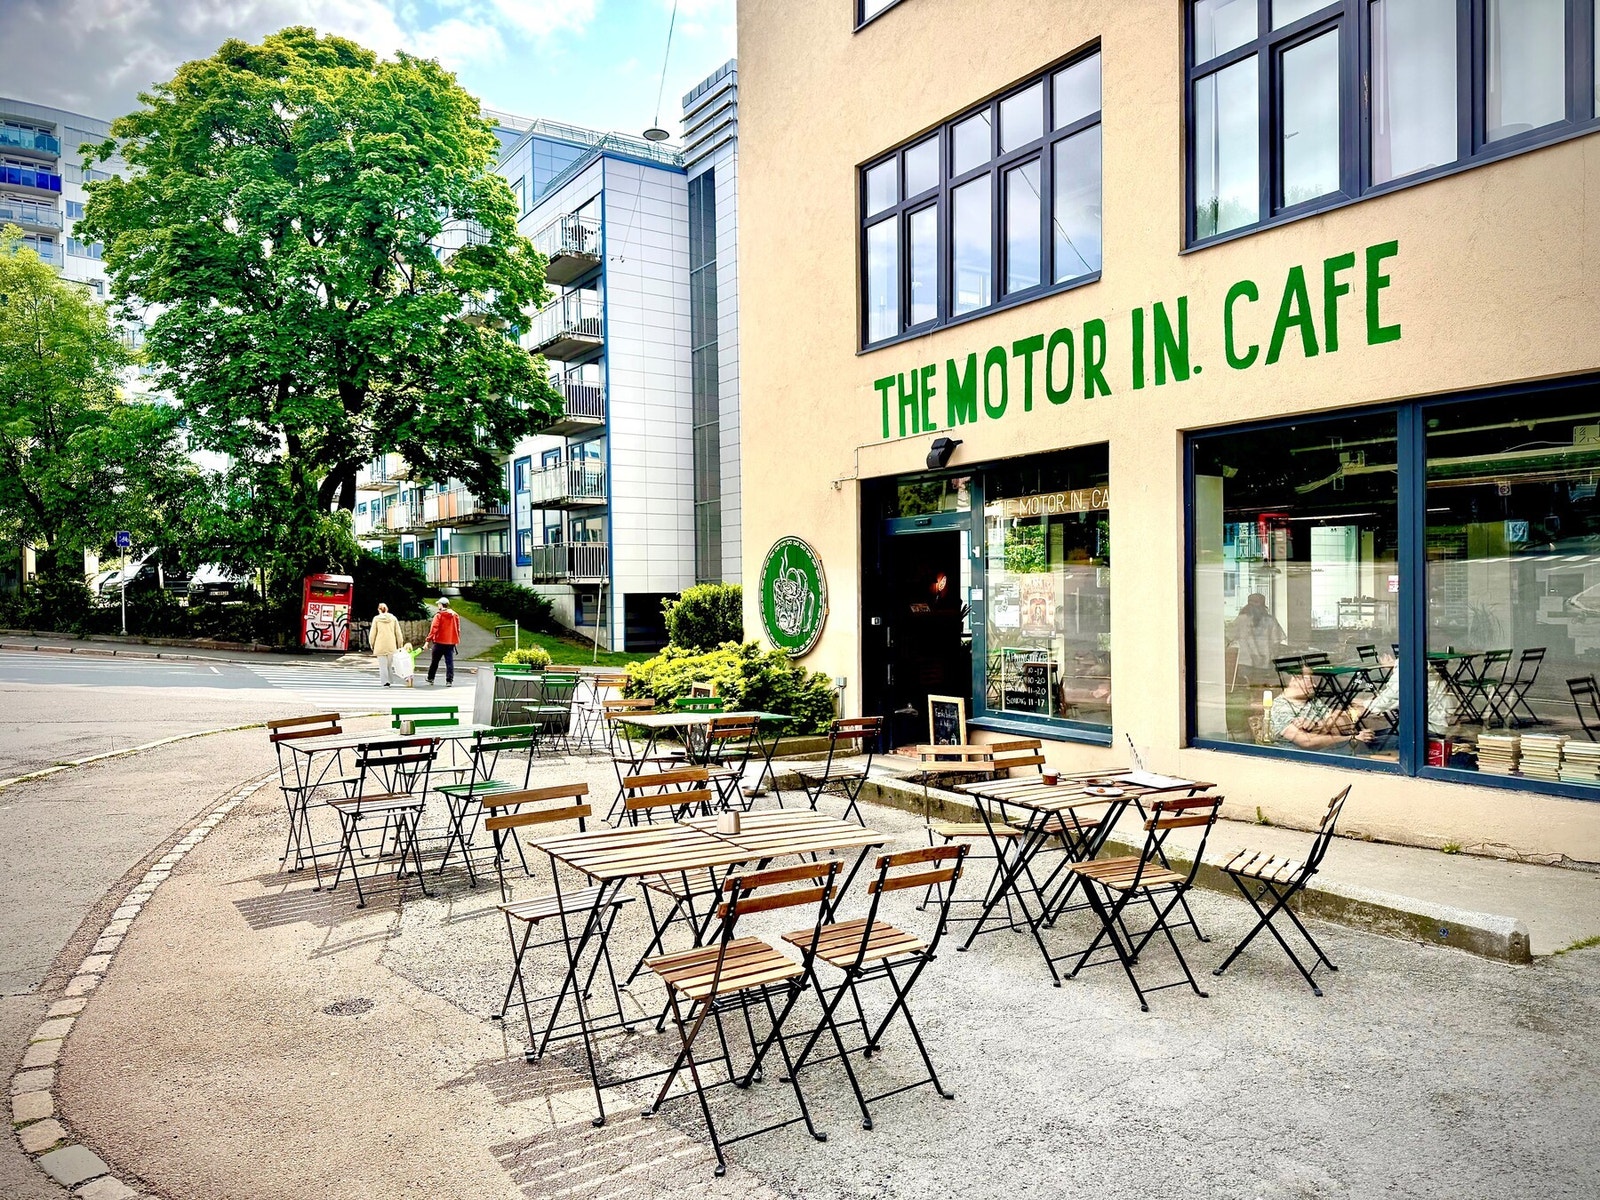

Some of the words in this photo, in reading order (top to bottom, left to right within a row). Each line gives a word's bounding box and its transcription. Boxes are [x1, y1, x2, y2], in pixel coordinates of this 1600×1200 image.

[874, 364, 937, 439] THE
[946, 318, 1111, 427] MOTOR
[1132, 296, 1202, 390] IN.
[1224, 240, 1402, 370] CAFE
[1019, 493, 1065, 516] MOTOR
[1070, 490, 1086, 511] IN.
